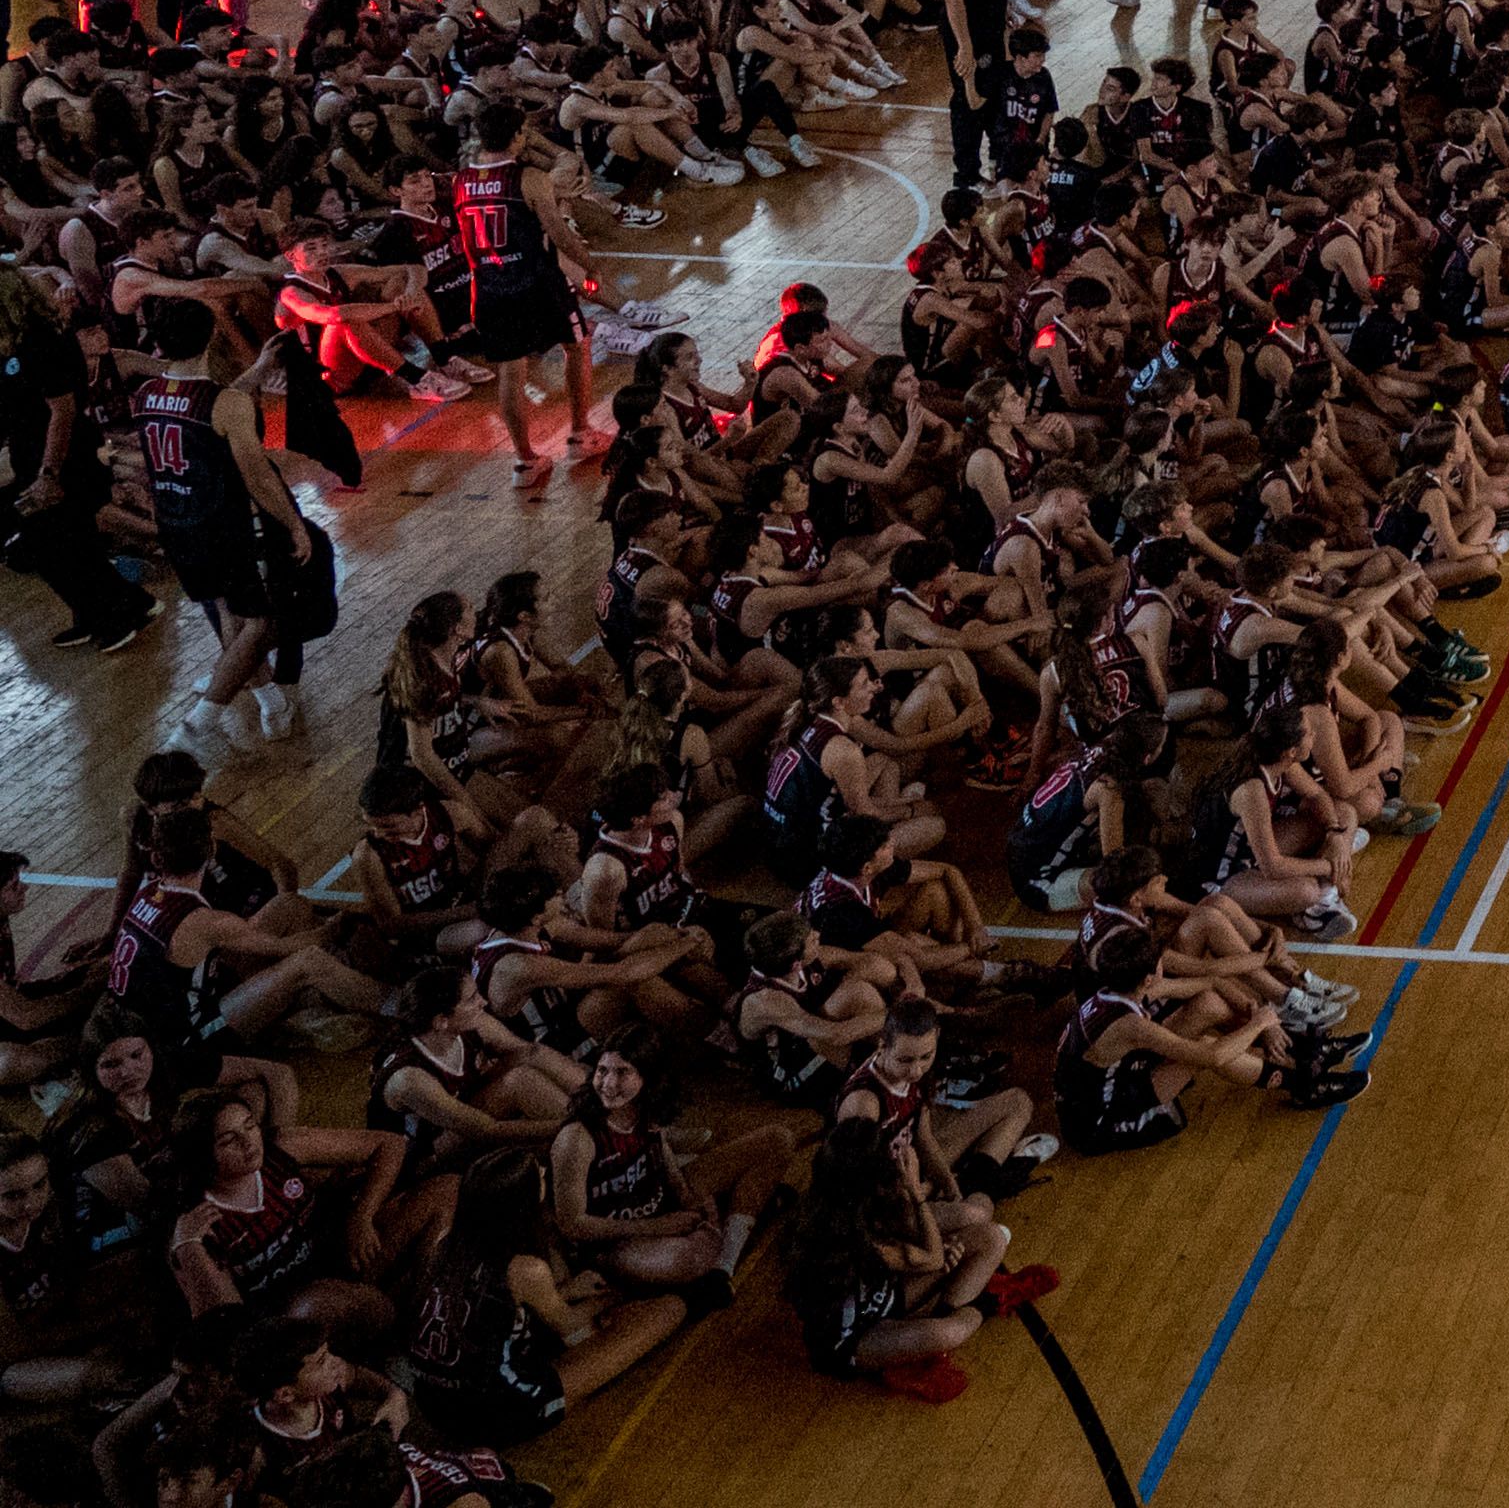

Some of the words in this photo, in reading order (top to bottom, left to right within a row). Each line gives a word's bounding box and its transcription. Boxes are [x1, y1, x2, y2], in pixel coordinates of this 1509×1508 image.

[464, 180, 502, 196] TIAGO
[145, 394, 190, 412] MARIO
[145, 422, 190, 477] 14
